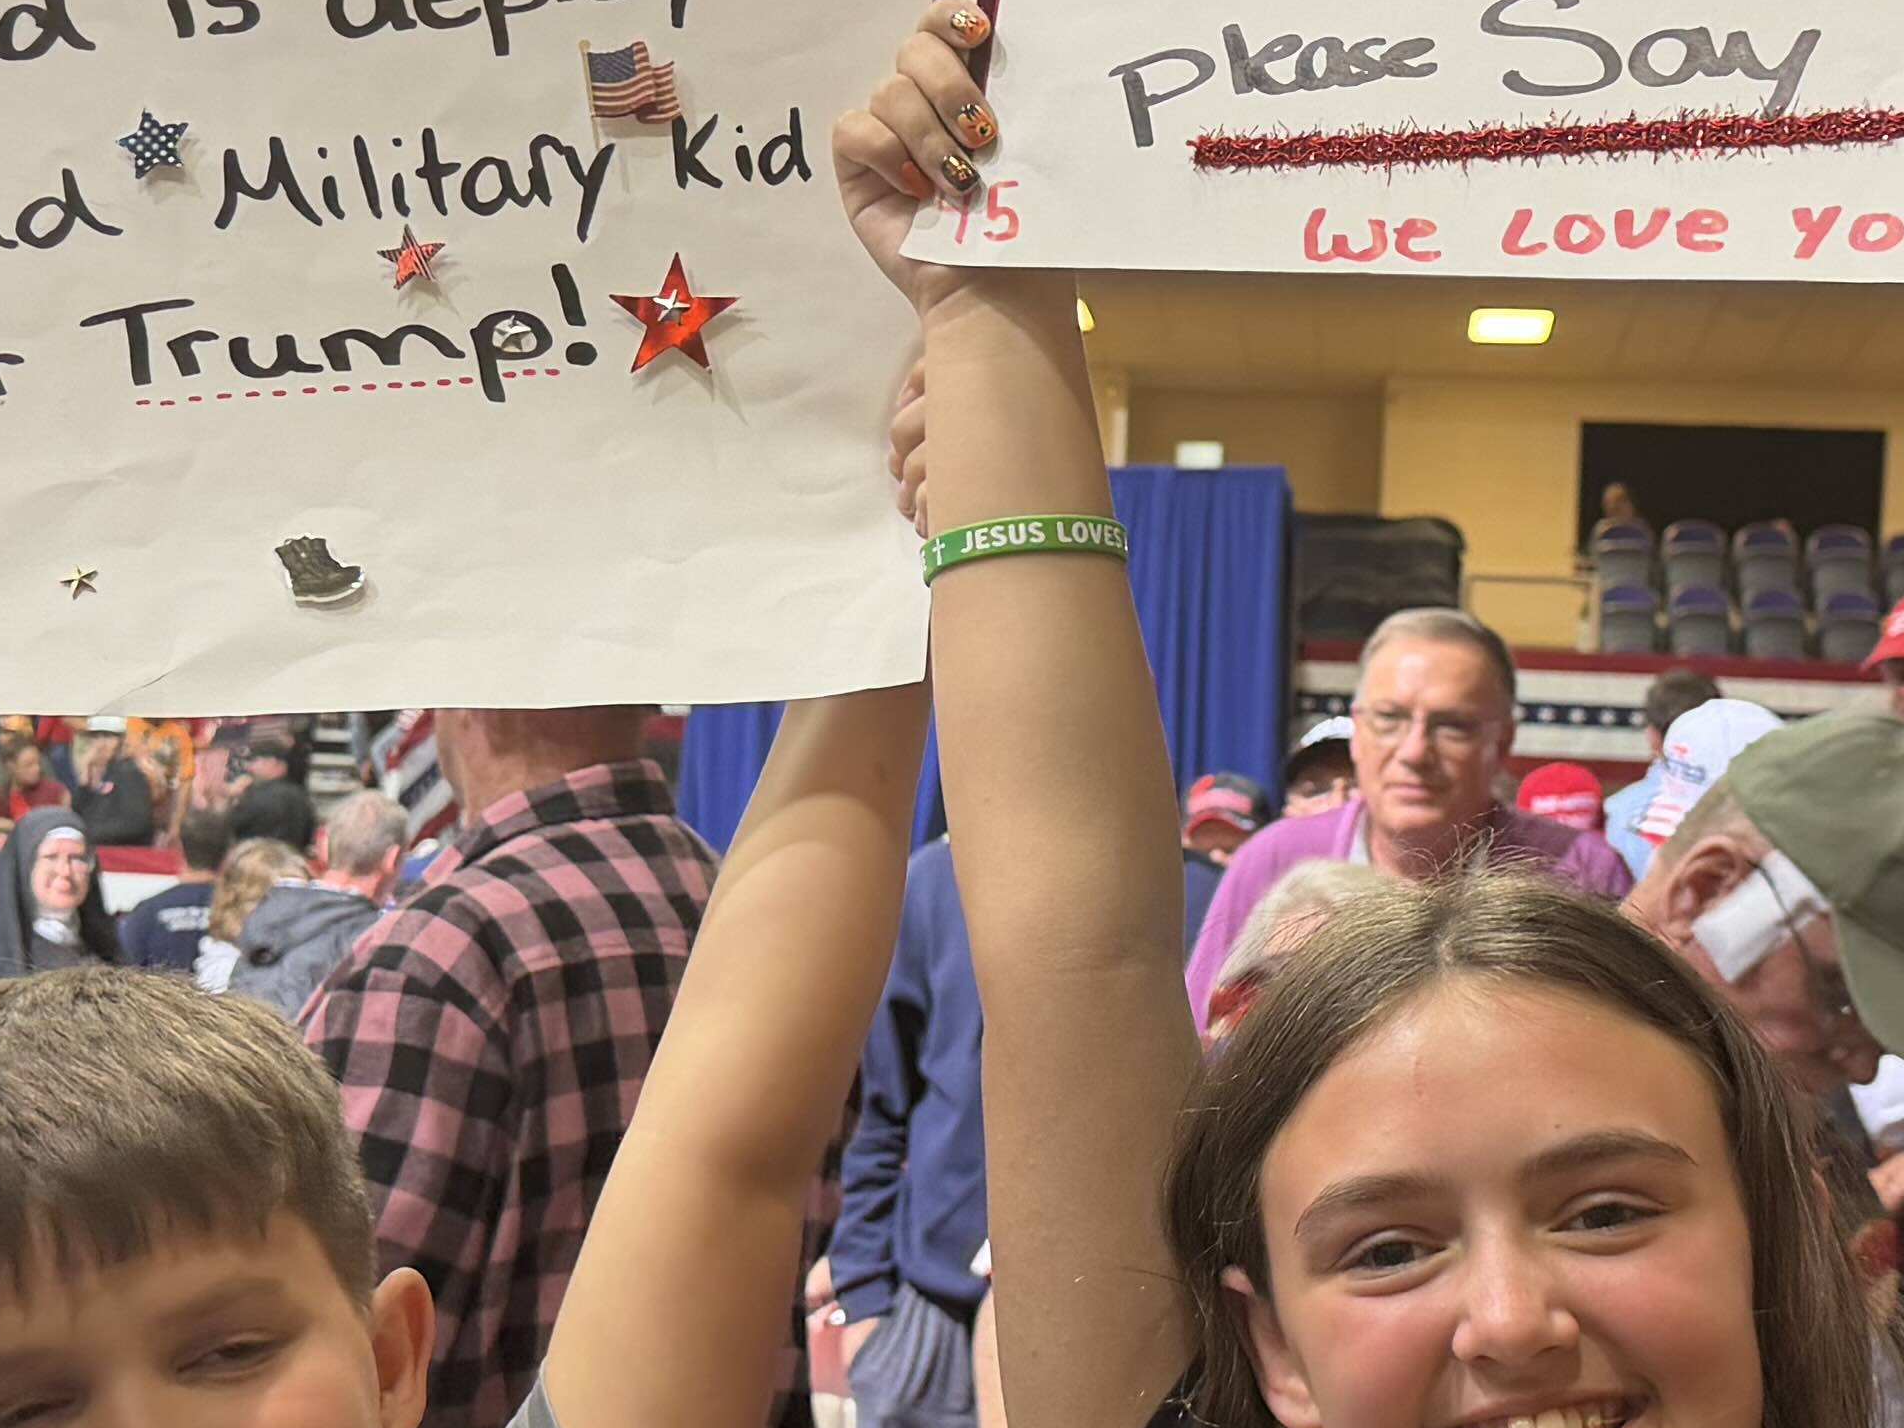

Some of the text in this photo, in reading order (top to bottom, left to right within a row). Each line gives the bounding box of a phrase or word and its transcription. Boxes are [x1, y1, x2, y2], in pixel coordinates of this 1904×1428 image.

[214, 127, 614, 242] Military
[80, 263, 597, 403] Trump!
[960, 521, 1046, 554] JESUS
[1056, 521, 1122, 549] LOVES
